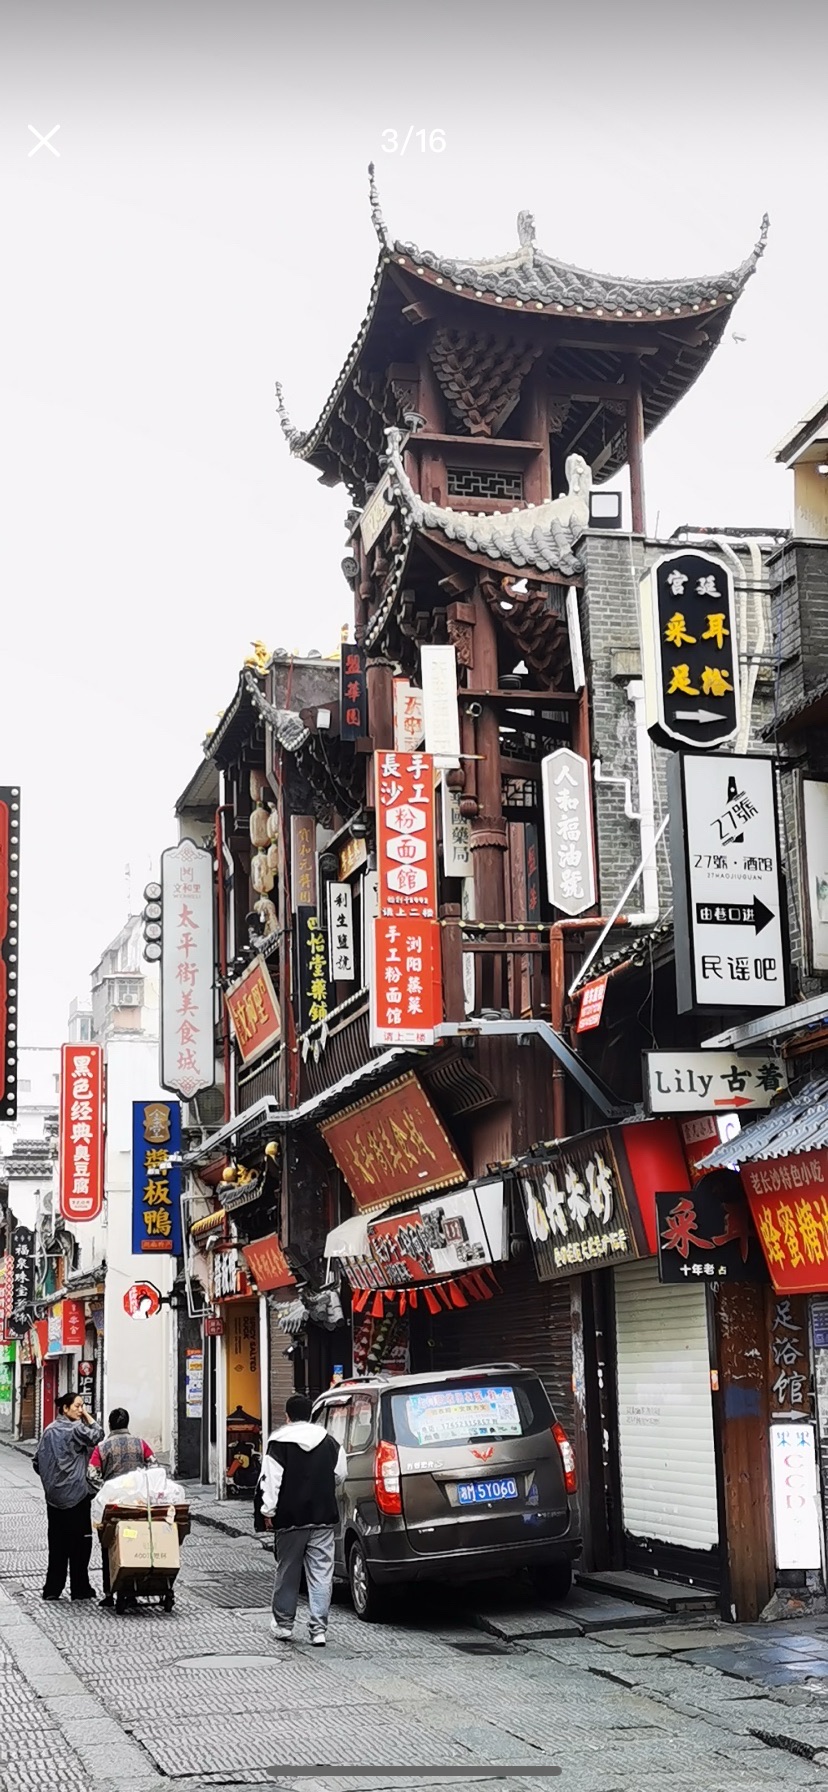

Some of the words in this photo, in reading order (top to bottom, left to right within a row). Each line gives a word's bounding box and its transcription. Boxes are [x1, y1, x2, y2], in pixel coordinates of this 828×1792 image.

[664, 611, 730, 649] 采耳
[406, 754, 430, 803] 手工
[553, 764, 584, 900] 人和福油號
[707, 872, 763, 881] 27HAOJIUGUAN
[700, 907, 756, 922] 由巷口进
[385, 925, 403, 1025] 手工粉面馆
[405, 935, 423, 1015] 浏阳蒸菜
[701, 955, 778, 981] 民谣吧
[175, 903, 201, 1075] 太平街美食城
[384, 1032, 426, 1043] 请上二楼
[654, 1068, 713, 1098] Lily
[720, 1062, 784, 1092] 古着
[750, 1159, 825, 1195] 老长沙特色小吃
[771, 1300, 807, 1405] 足浴馆
